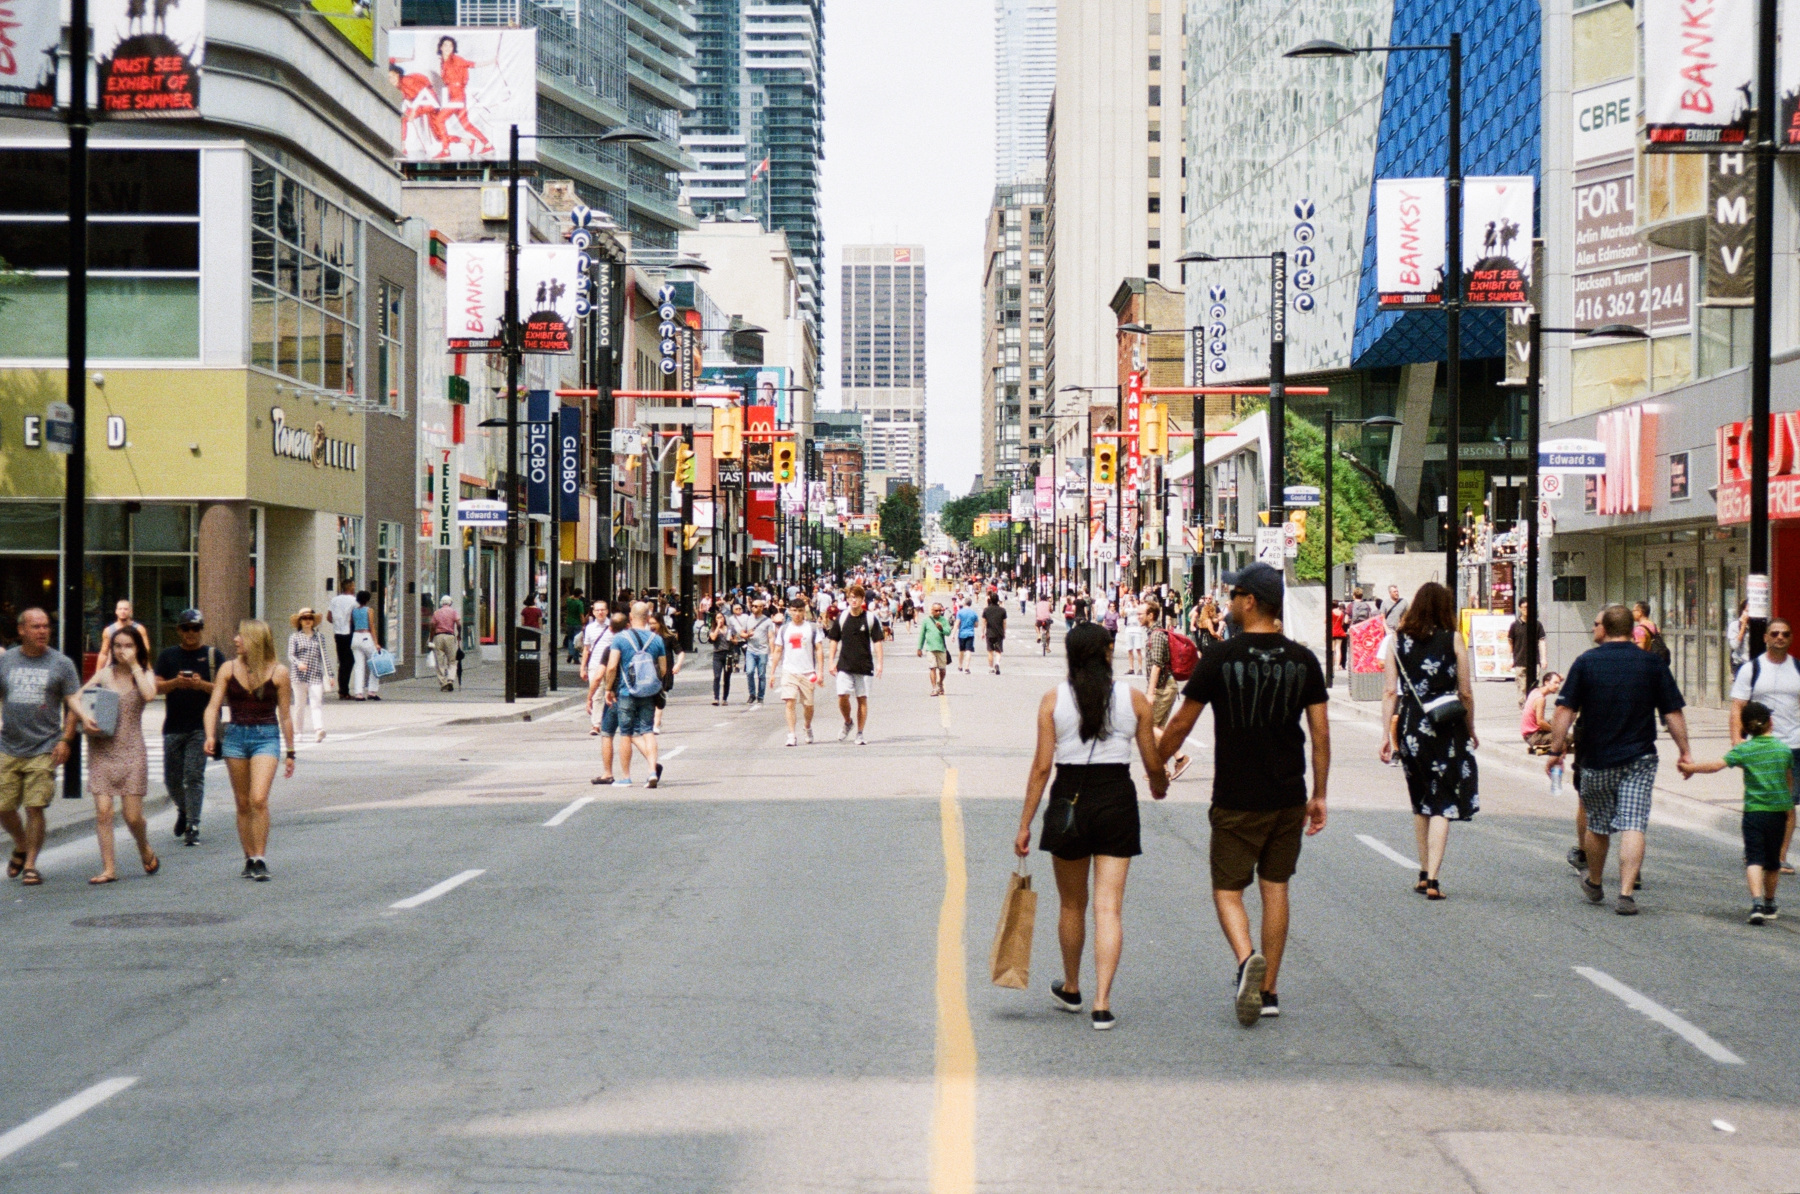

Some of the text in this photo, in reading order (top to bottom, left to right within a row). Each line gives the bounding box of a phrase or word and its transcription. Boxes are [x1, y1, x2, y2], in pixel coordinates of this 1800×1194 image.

[113, 57, 183, 73] MUST SEE
[106, 74, 189, 91] EXHIBIT OF
[104, 93, 193, 110] THE SUMMER
[1579, 97, 1631, 132] CBRE
[1577, 182, 1619, 221] FOR
[1399, 190, 1423, 286] BANKSY
[1576, 228, 1599, 245] Arlin
[1576, 251, 1596, 266] Alex
[1474, 270, 1519, 279] MUST SEE
[465, 252, 485, 332] BANKSY
[1470, 281, 1523, 290] EXHIBIT OF
[1576, 275, 1611, 292] Jackson
[600, 263, 610, 346] DOWNTOWN
[1274, 258, 1284, 341] DOWNTOWN
[1467, 292, 1525, 302] THE SUMMER
[1576, 283, 1684, 321] 416 362 2244
[528, 322, 564, 330] MUST SEE
[526, 331, 568, 339] EXHIBIT OF
[524, 340, 569, 350] THE SUMMER
[1195, 331, 1203, 388] DOWNTOW
[531, 424, 546, 483] GLOBO
[1549, 454, 1595, 465] Edward St
[562, 436, 577, 494] GLOBO
[1459, 481, 1479, 489] CLOSED
[465, 510, 492, 519] Edward
[1100, 550, 1112, 560] 40
